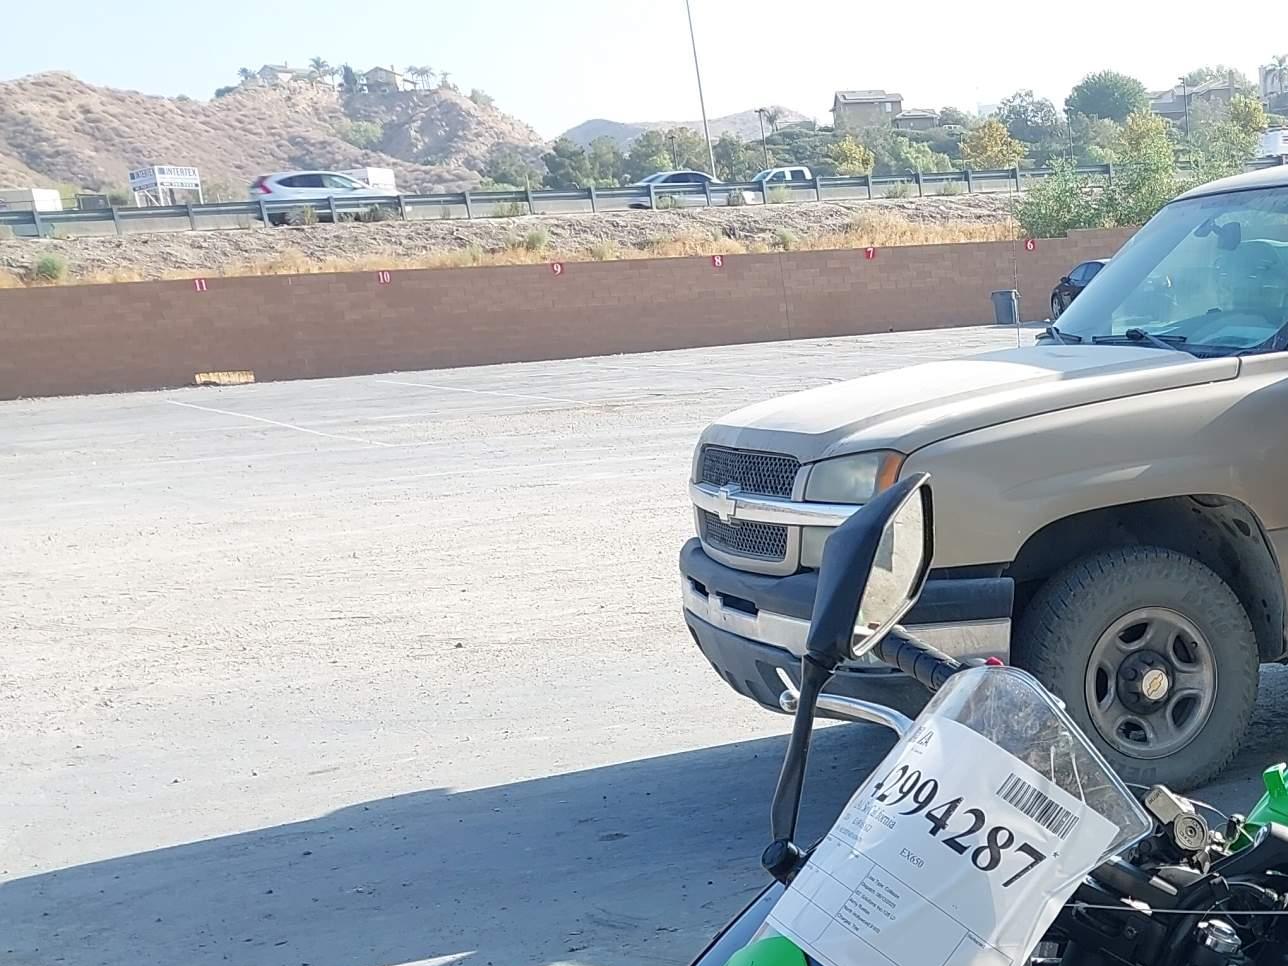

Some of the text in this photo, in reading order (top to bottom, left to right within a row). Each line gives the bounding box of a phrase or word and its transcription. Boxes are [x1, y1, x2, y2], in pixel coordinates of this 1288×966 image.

[166, 167, 197, 177] INTERTEX
[1026, 240, 1034, 250] 6
[866, 247, 875, 258] 7
[714, 255, 722, 267] 8
[553, 263, 562, 275] 9
[378, 271, 391, 283] 10
[194, 279, 208, 292] 11
[899, 847, 925, 869] EX650
